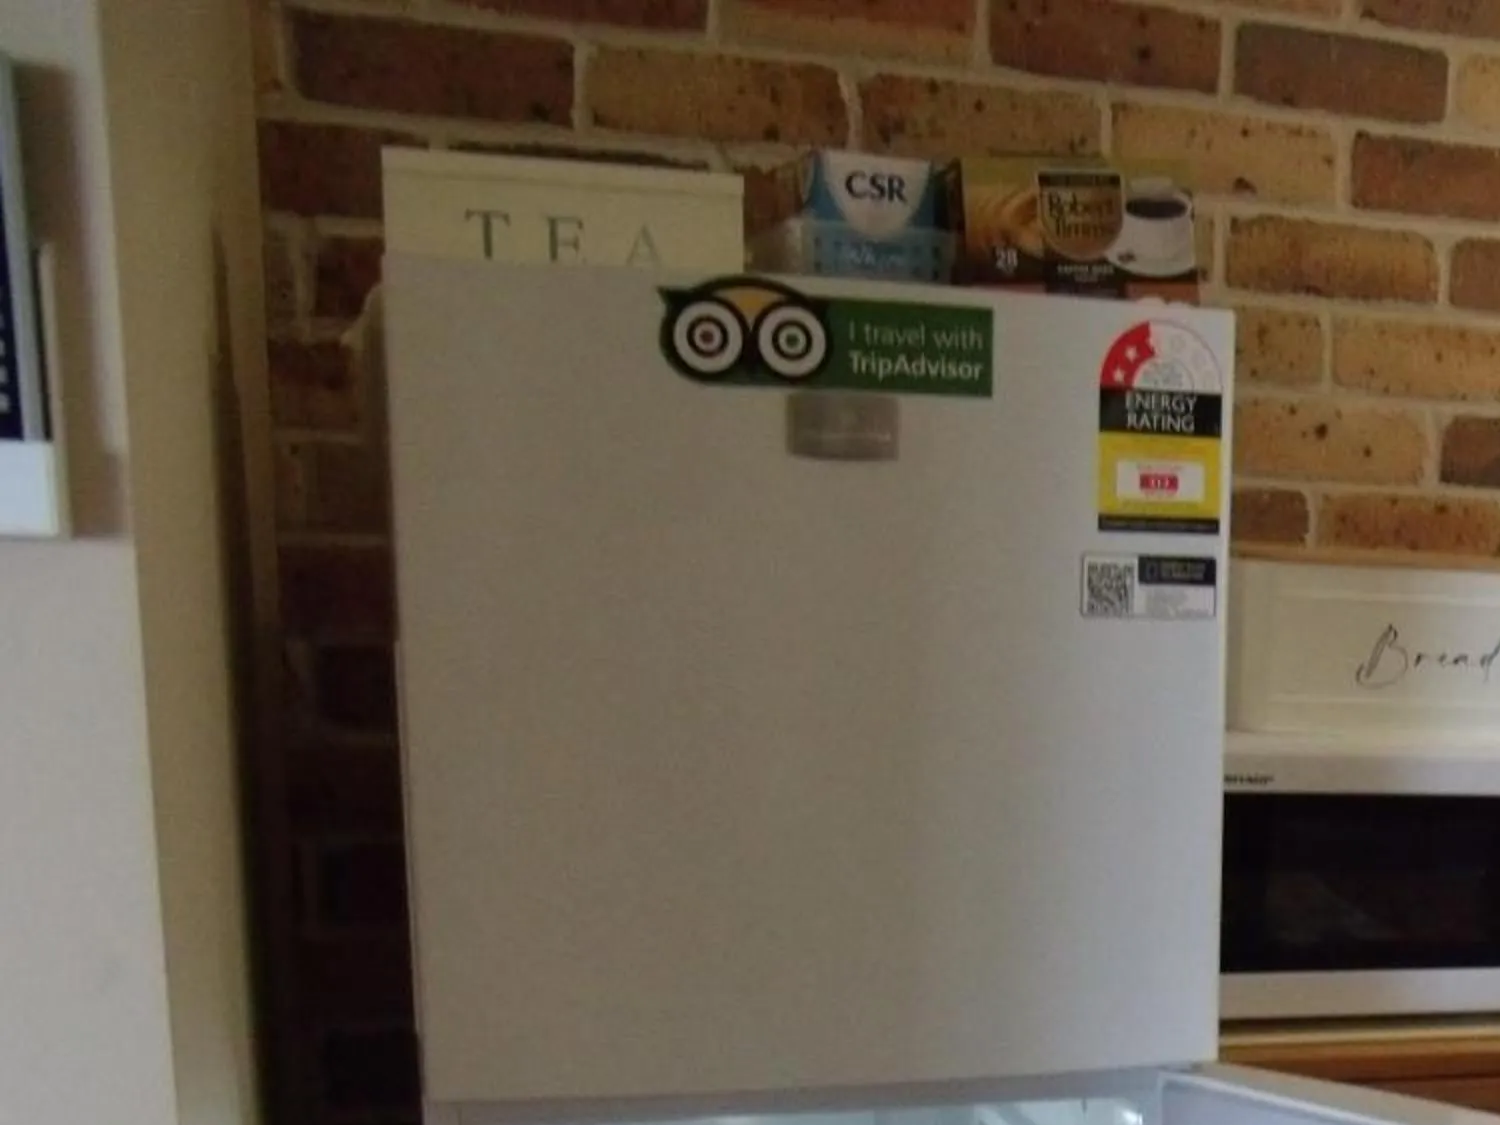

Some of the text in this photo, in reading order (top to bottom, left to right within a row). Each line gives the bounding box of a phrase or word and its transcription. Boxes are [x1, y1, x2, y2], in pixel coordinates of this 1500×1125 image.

[845, 170, 908, 203] CSR
[864, 322, 926, 346] travel
[933, 326, 984, 350] with
[849, 350, 984, 383] TripAdvisor
[1125, 391, 1197, 413] ENERGY
[1127, 412, 1195, 433] RATING
